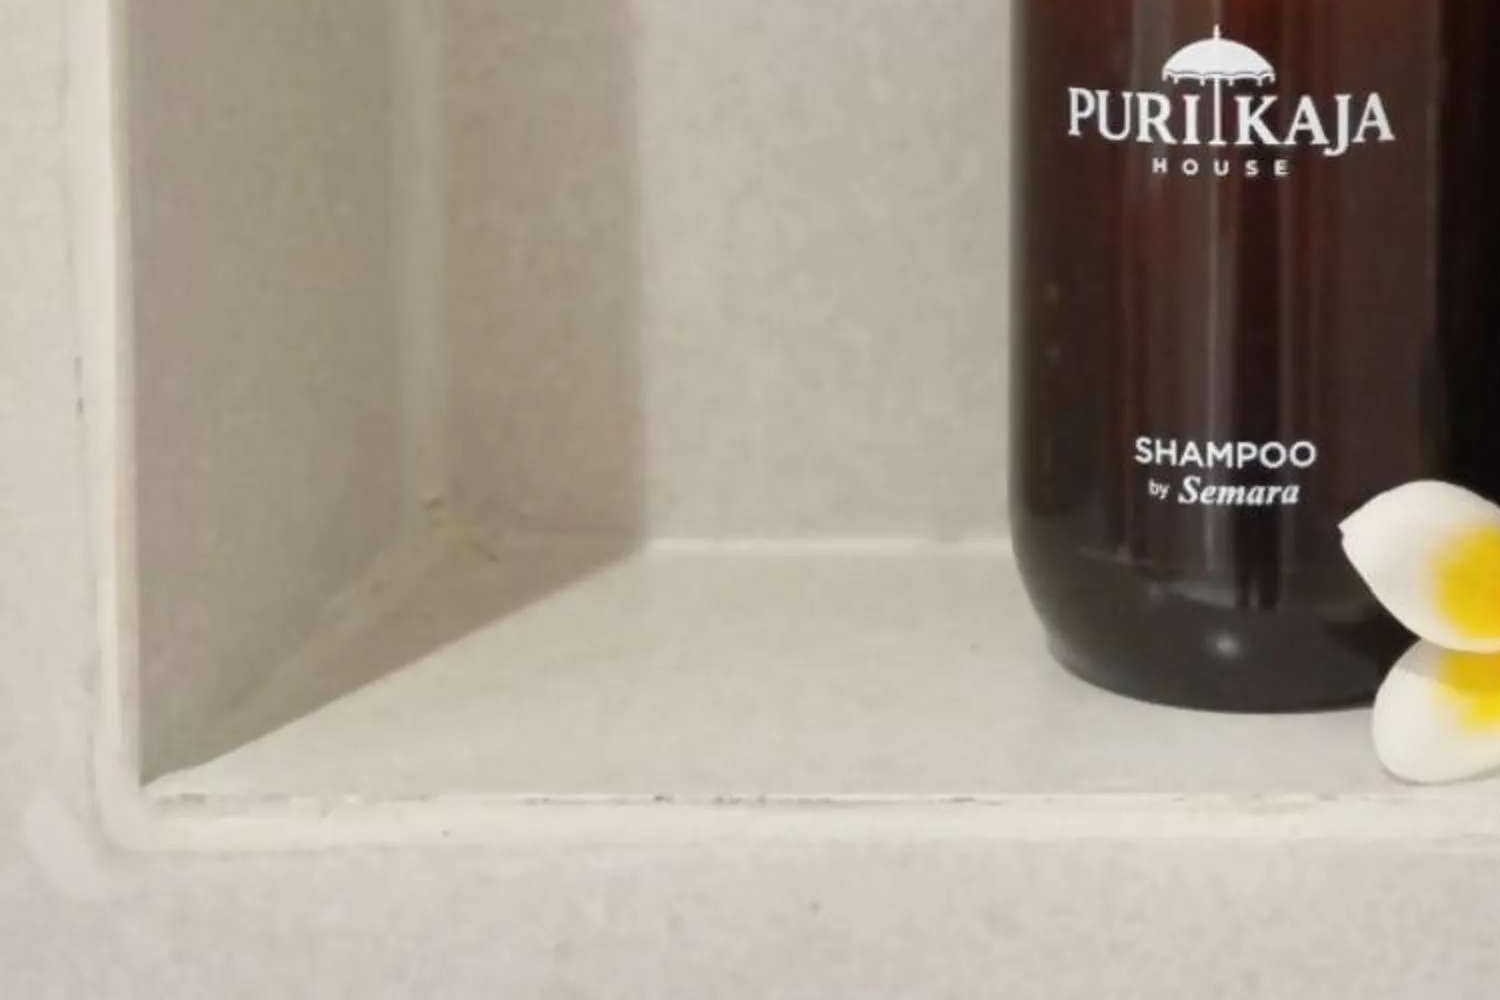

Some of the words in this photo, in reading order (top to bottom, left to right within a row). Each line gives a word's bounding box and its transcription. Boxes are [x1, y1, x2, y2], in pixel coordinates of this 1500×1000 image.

[1068, 86, 1201, 146] PURI
[1233, 92, 1395, 157] KAJA
[1152, 157, 1289, 177] HOUSE
[1134, 436, 1317, 469] SHAMPOO
[1148, 479, 1170, 500] by
[1177, 474, 1300, 506] Semara
